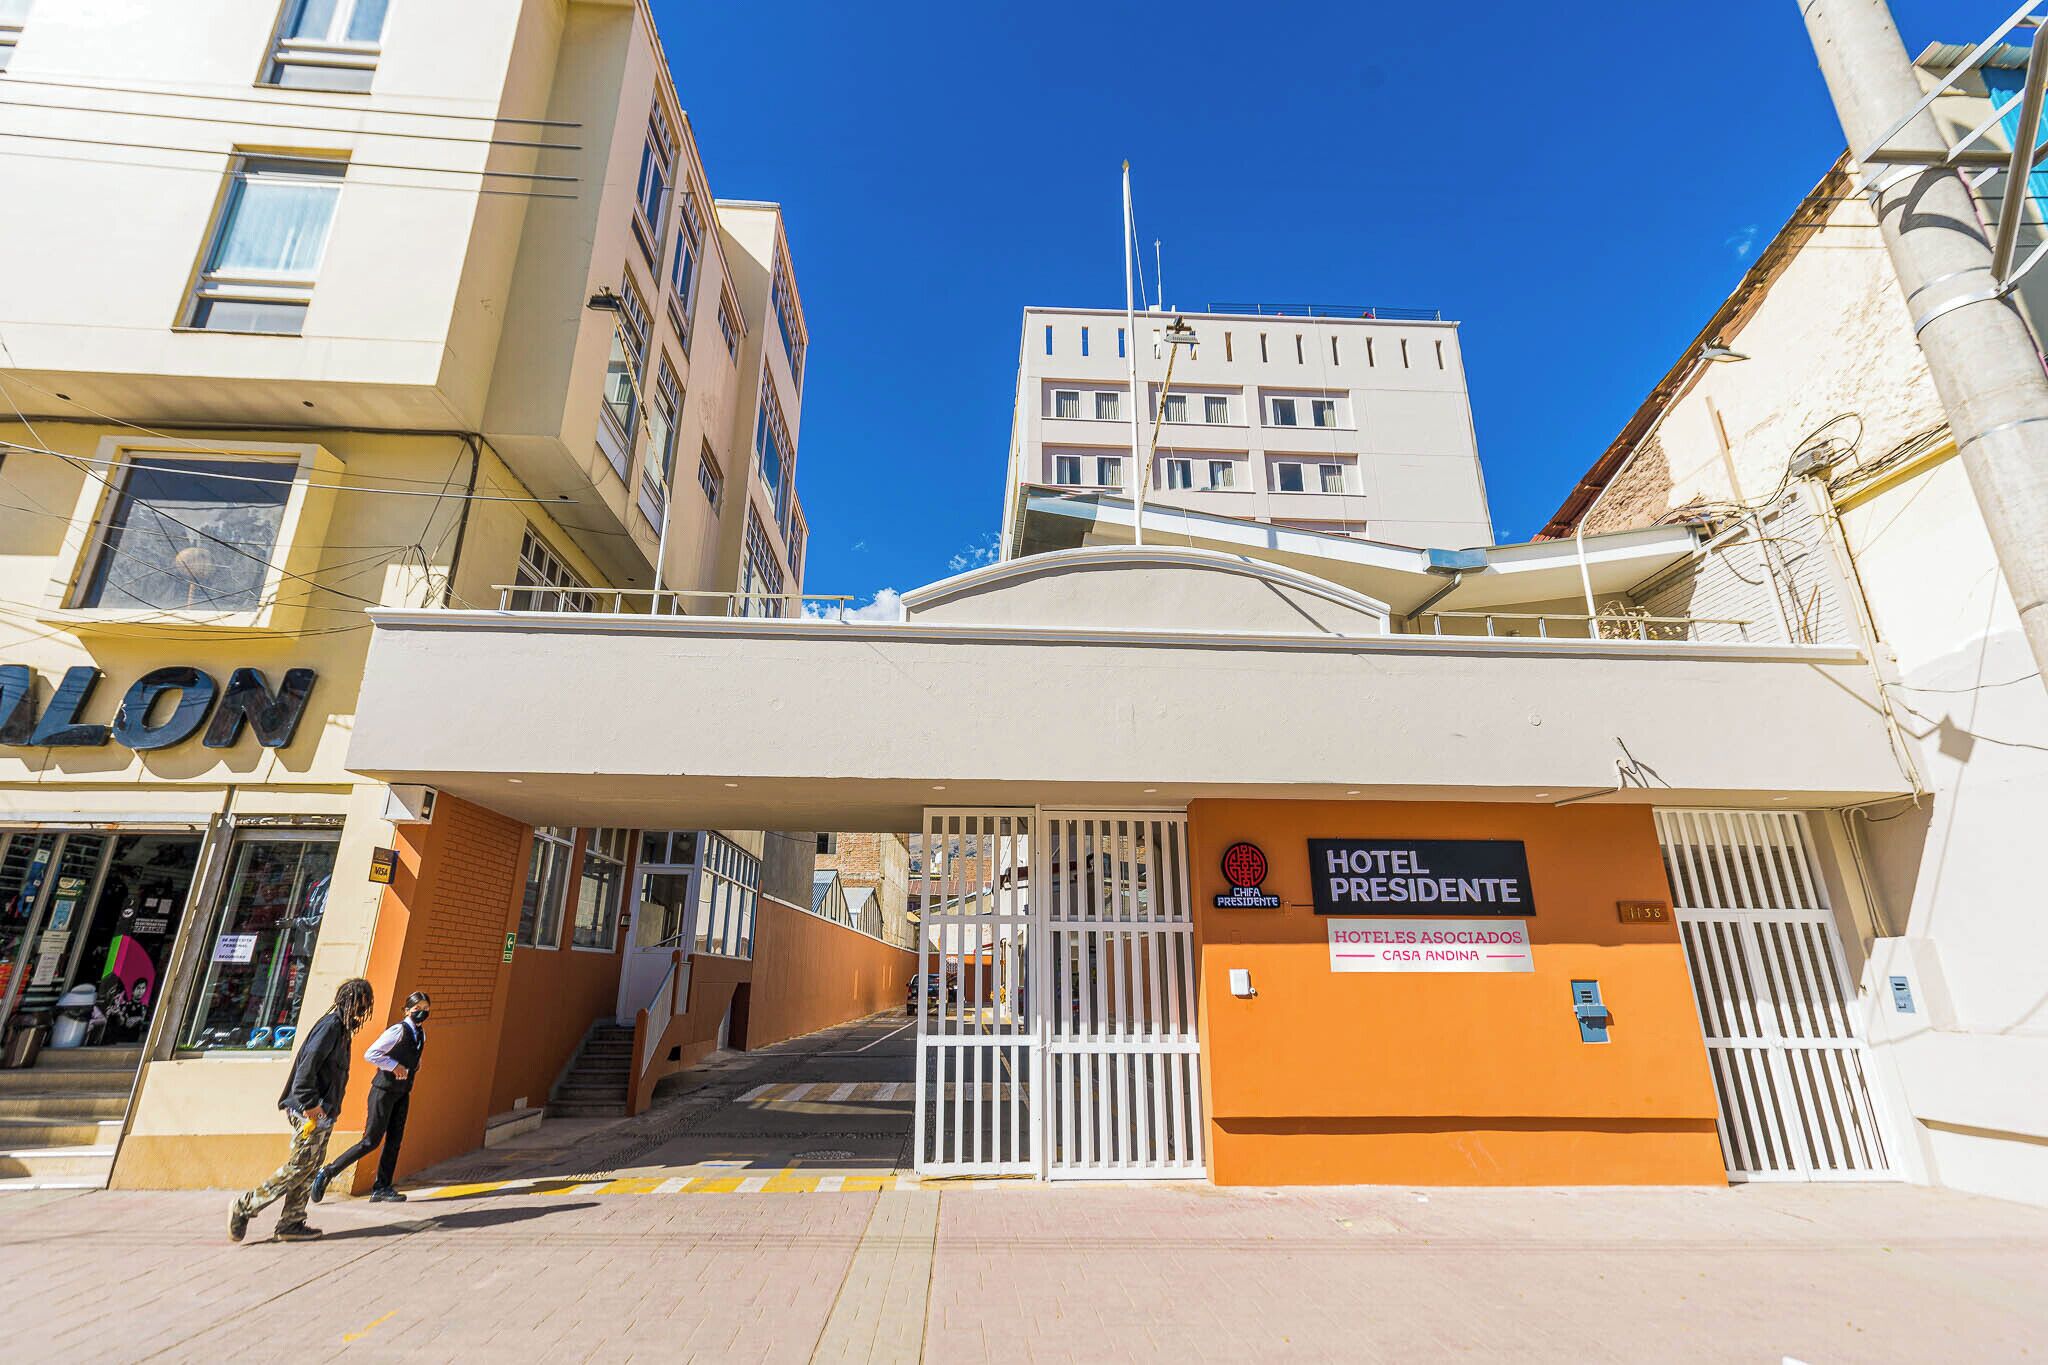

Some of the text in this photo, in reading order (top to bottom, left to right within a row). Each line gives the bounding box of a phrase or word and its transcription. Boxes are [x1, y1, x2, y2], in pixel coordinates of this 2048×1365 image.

[1326, 850, 1430, 874] HOTEL
[375, 866, 388, 876] VISA
[1233, 887, 1261, 897] CHIFA
[1329, 877, 1521, 903] PRESIDENTE
[1217, 897, 1279, 907] PRESIDENTE
[1630, 907, 1661, 919] 1138
[1334, 930, 1523, 945] HOTELES ASOCIADOS
[1382, 950, 1480, 961] CASA ANDINA
